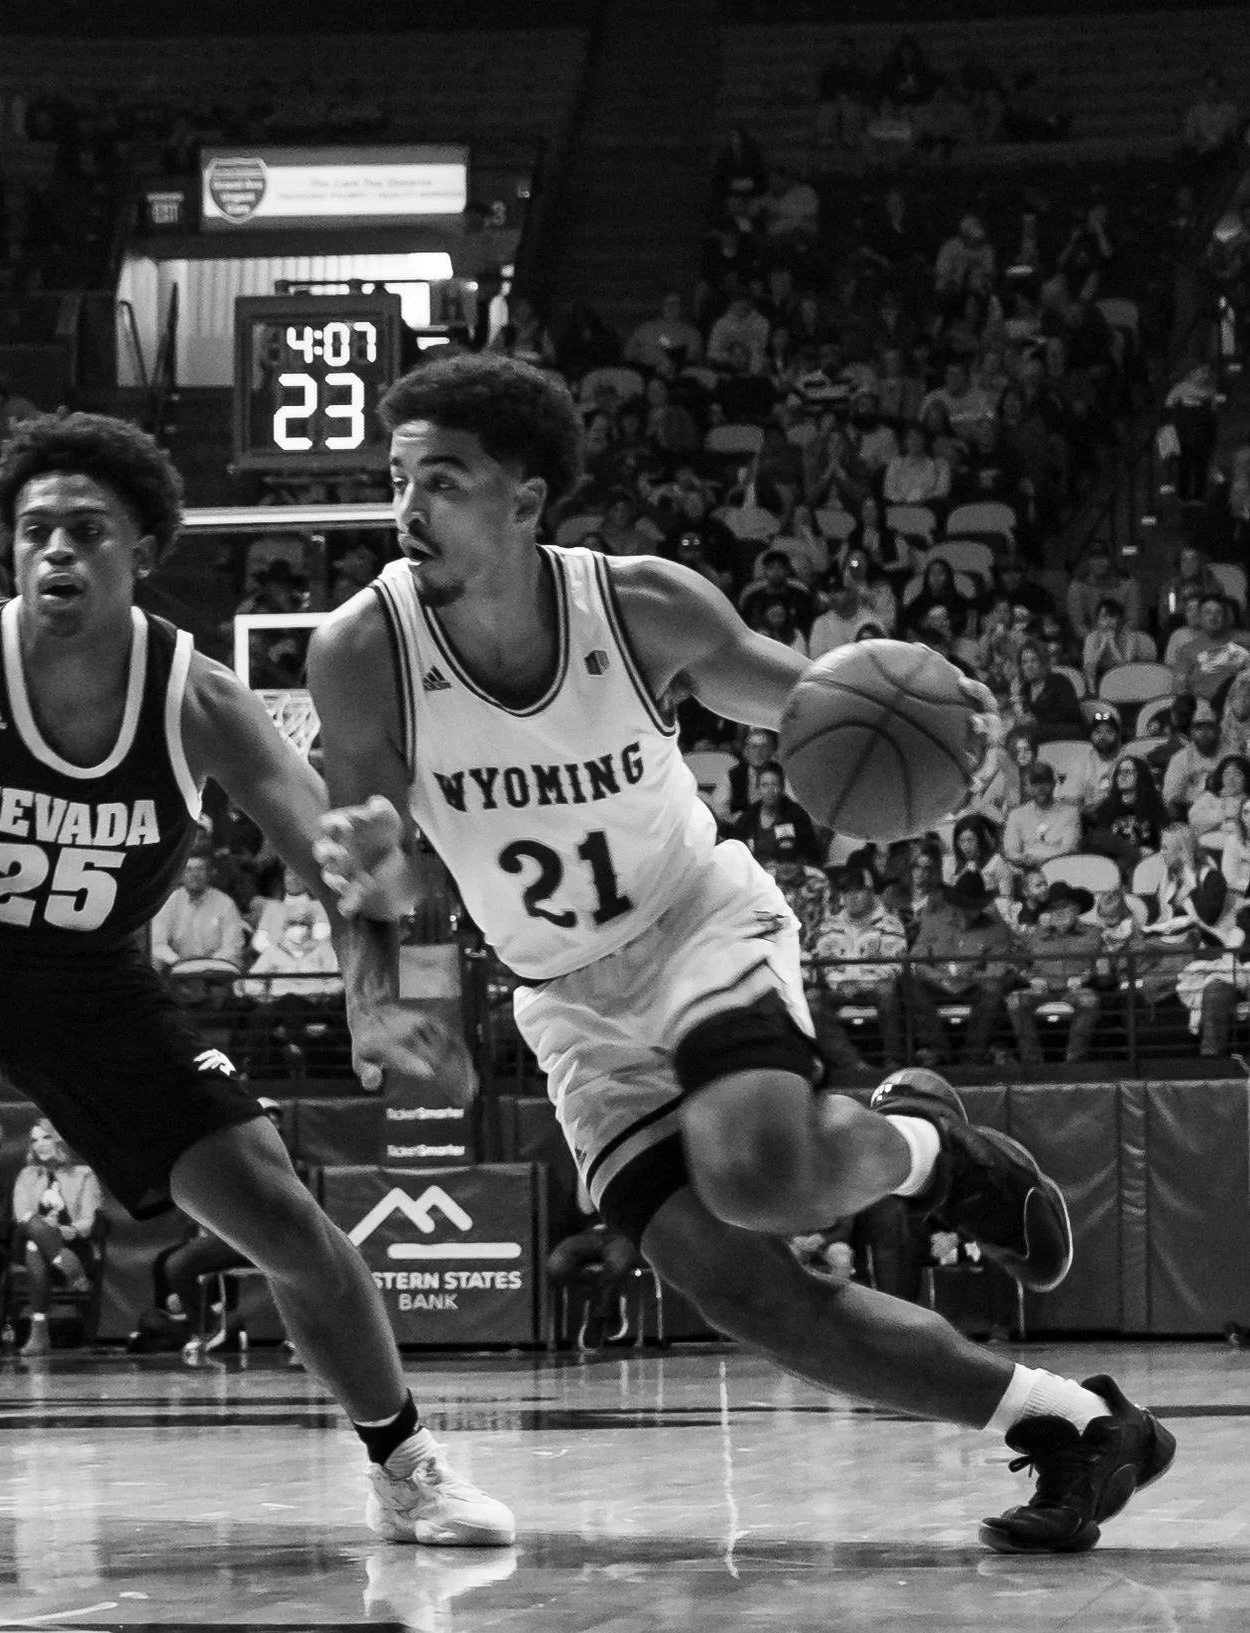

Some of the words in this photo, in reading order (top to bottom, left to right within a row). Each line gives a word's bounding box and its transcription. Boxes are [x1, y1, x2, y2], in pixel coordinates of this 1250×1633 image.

[286, 322, 377, 367] 4:07
[273, 372, 365, 450] 23
[432, 741, 644, 813] WYOMING
[498, 830, 634, 928] 21
[398, 1293, 458, 1311] BANK
[444, 1270, 522, 1290] STATES
